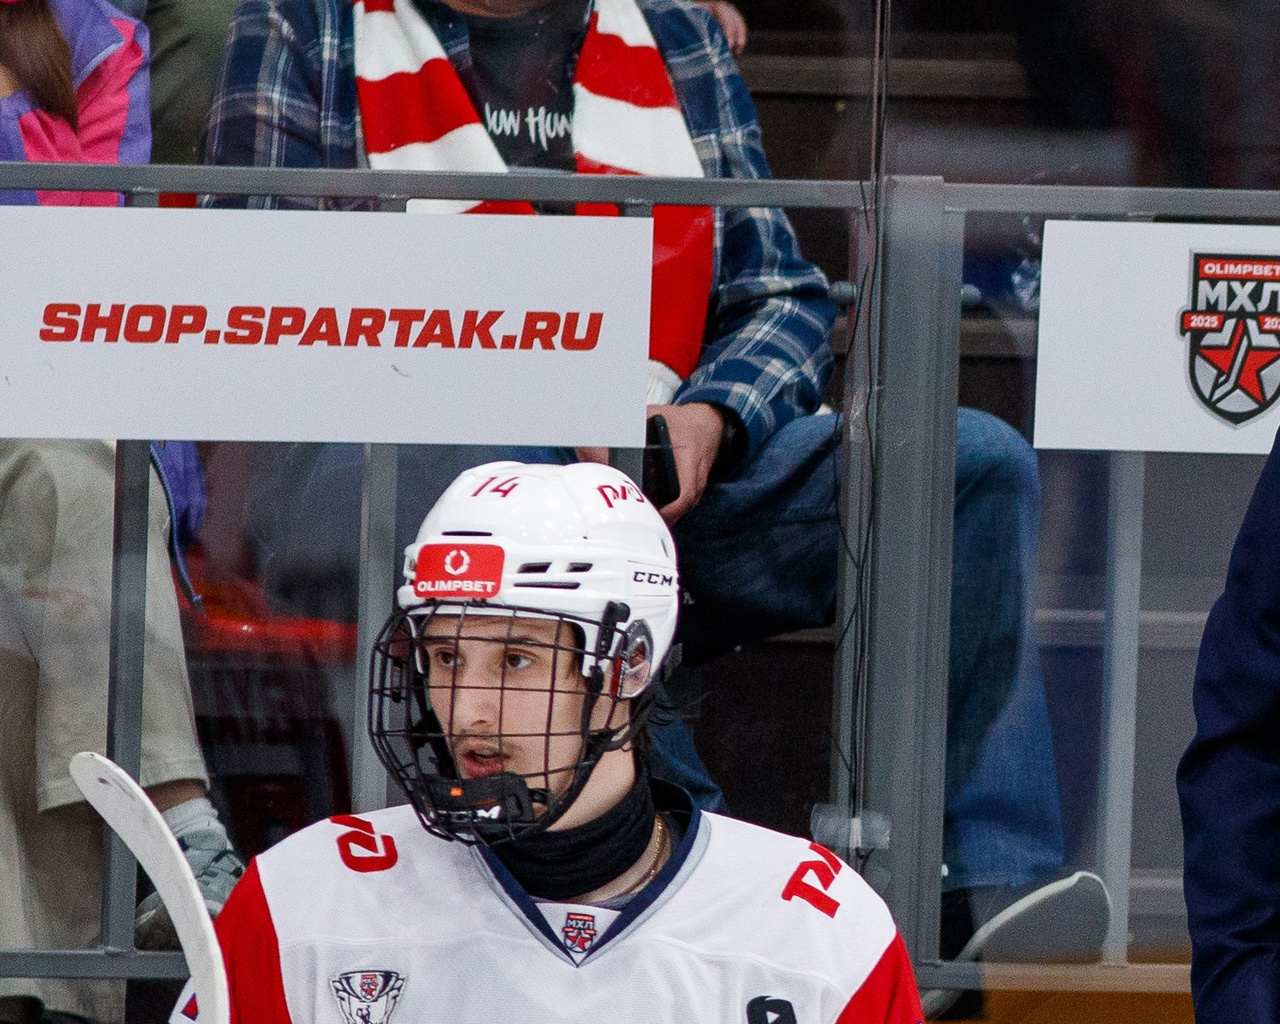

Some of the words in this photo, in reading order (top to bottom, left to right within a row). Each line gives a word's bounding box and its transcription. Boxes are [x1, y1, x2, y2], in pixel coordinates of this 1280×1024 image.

[39, 303, 604, 352] SHOP.SPARTAK.RU
[1189, 314, 1219, 328] 2025
[470, 476, 520, 499] 14
[417, 580, 496, 593] OLIMPBET
[632, 571, 674, 587] CCM
